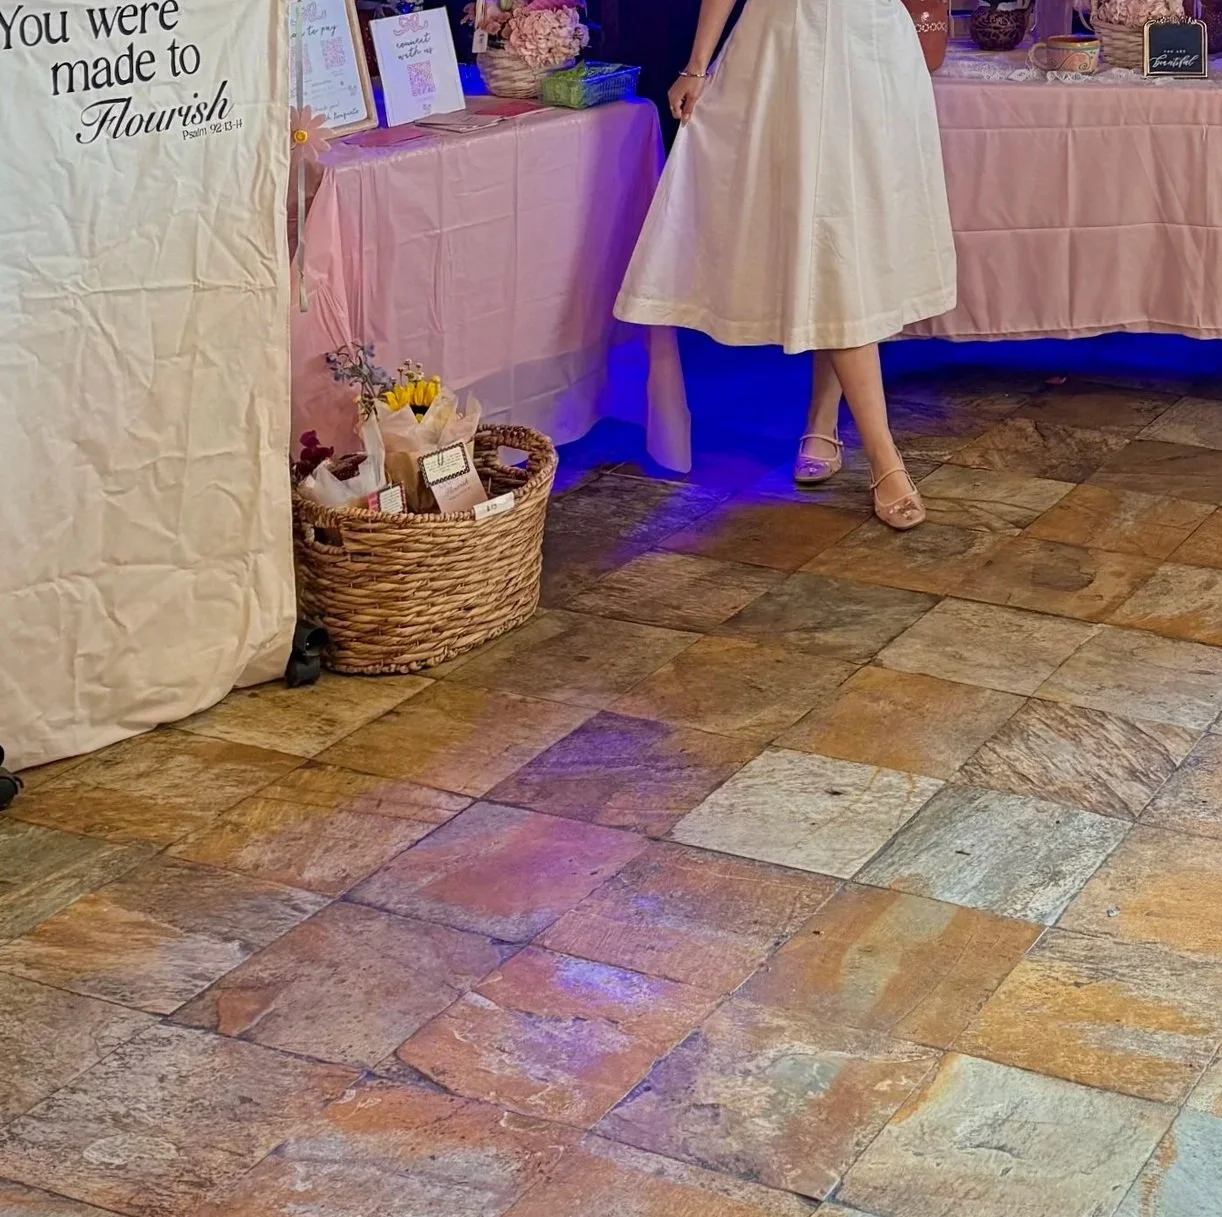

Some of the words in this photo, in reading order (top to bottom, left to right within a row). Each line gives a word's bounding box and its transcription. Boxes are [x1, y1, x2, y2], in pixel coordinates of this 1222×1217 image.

[0, 4, 70, 50] You
[51, 42, 157, 96] made
[167, 38, 201, 78] to
[75, 80, 236, 145] Flourish
[182, 127, 208, 141] Psalm
